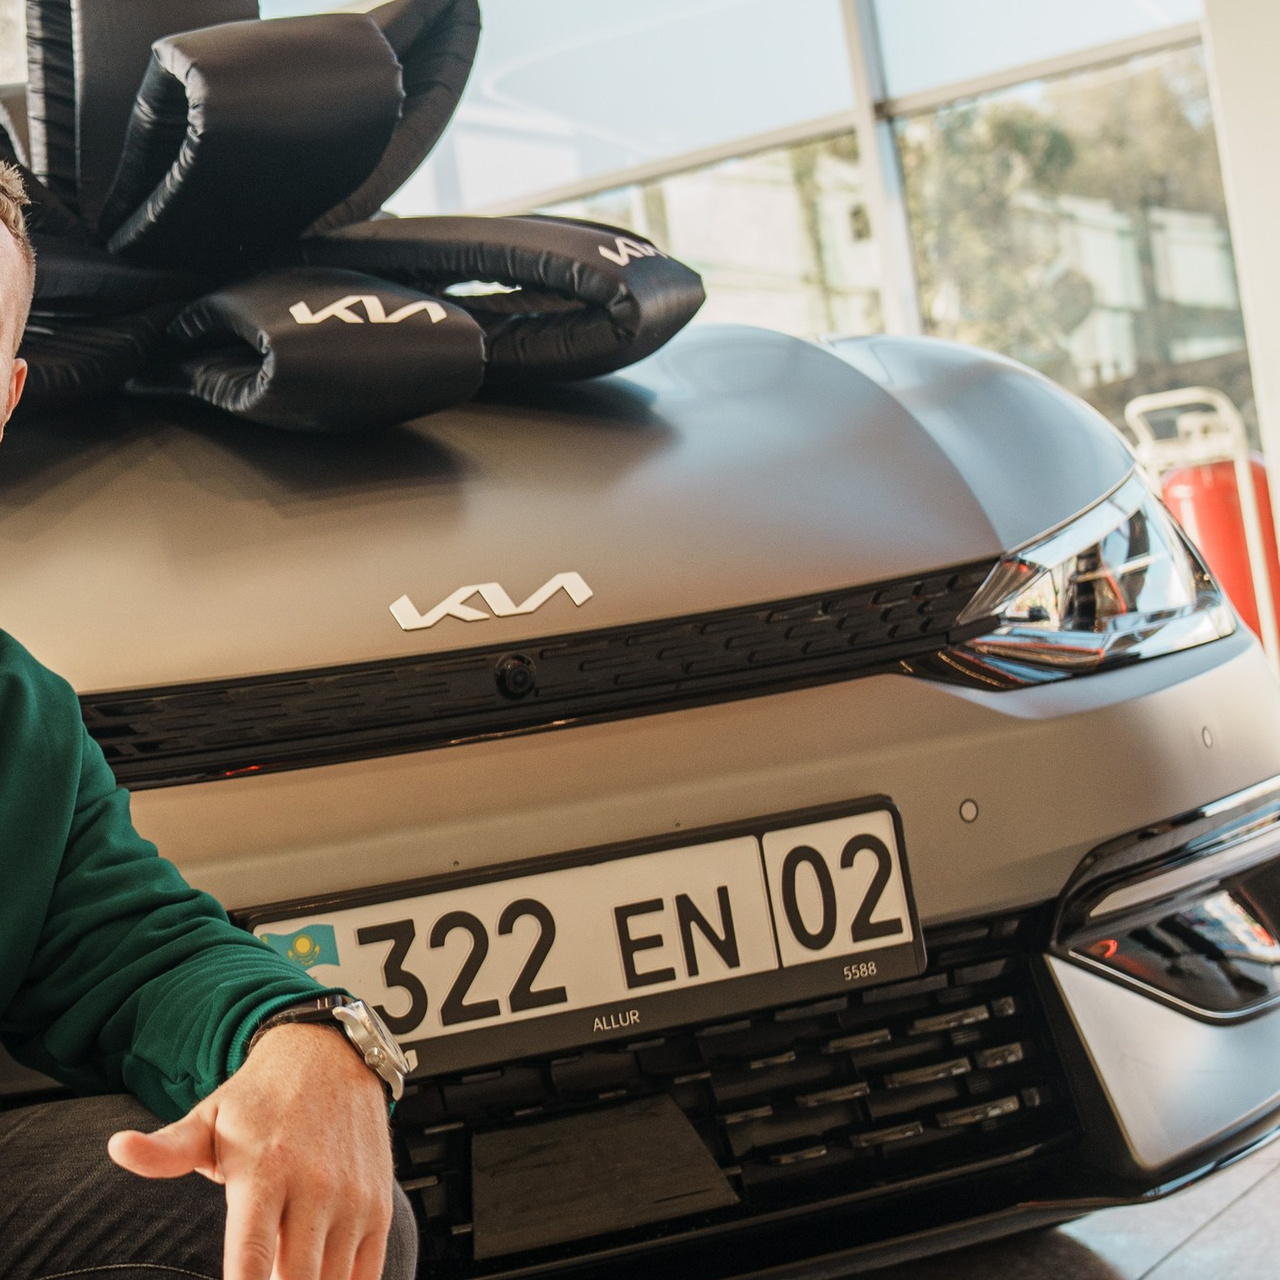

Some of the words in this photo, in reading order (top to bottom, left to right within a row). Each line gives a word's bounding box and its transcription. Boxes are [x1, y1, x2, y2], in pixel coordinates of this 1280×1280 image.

[289, 294, 447, 324] KIA
[389, 571, 593, 631] KIA
[356, 898, 568, 1035] 322
[614, 885, 740, 989] EN
[781, 833, 904, 951] 02
[842, 961, 878, 981] 5588
[592, 1009, 641, 1032] ALLUR
